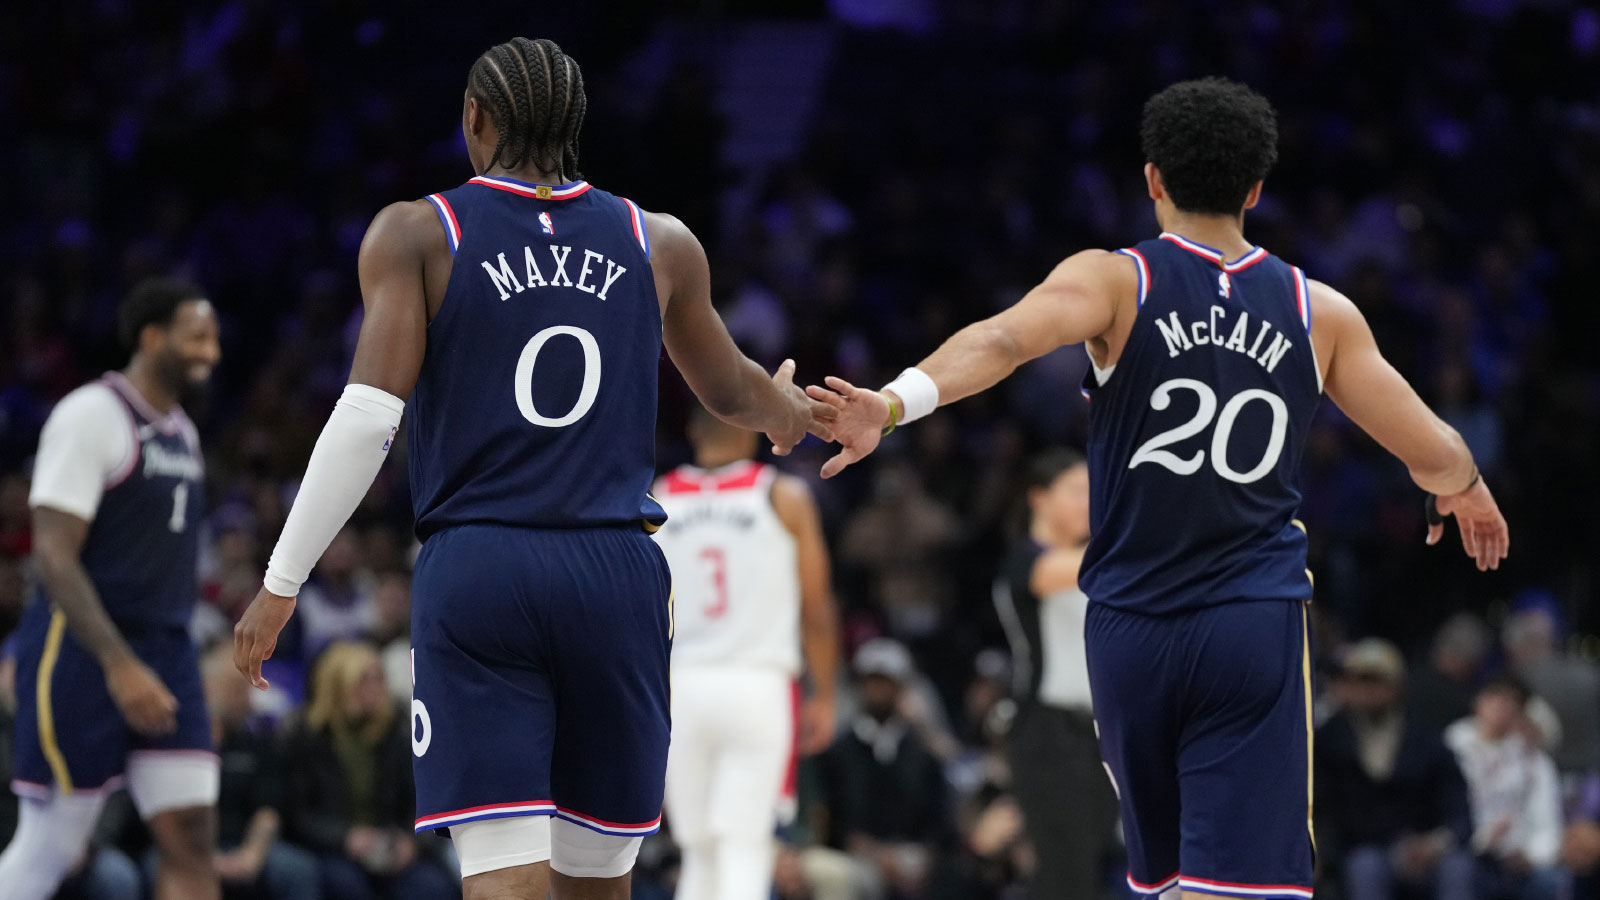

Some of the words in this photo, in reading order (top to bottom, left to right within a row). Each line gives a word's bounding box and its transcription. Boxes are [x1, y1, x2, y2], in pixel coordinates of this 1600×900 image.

[481, 245, 627, 301] MAXEY
[1155, 305, 1292, 373] McCAIN
[515, 325, 601, 427] 0
[1128, 378, 1288, 484] 20
[169, 482, 188, 533] 1
[699, 546, 729, 622] 3
